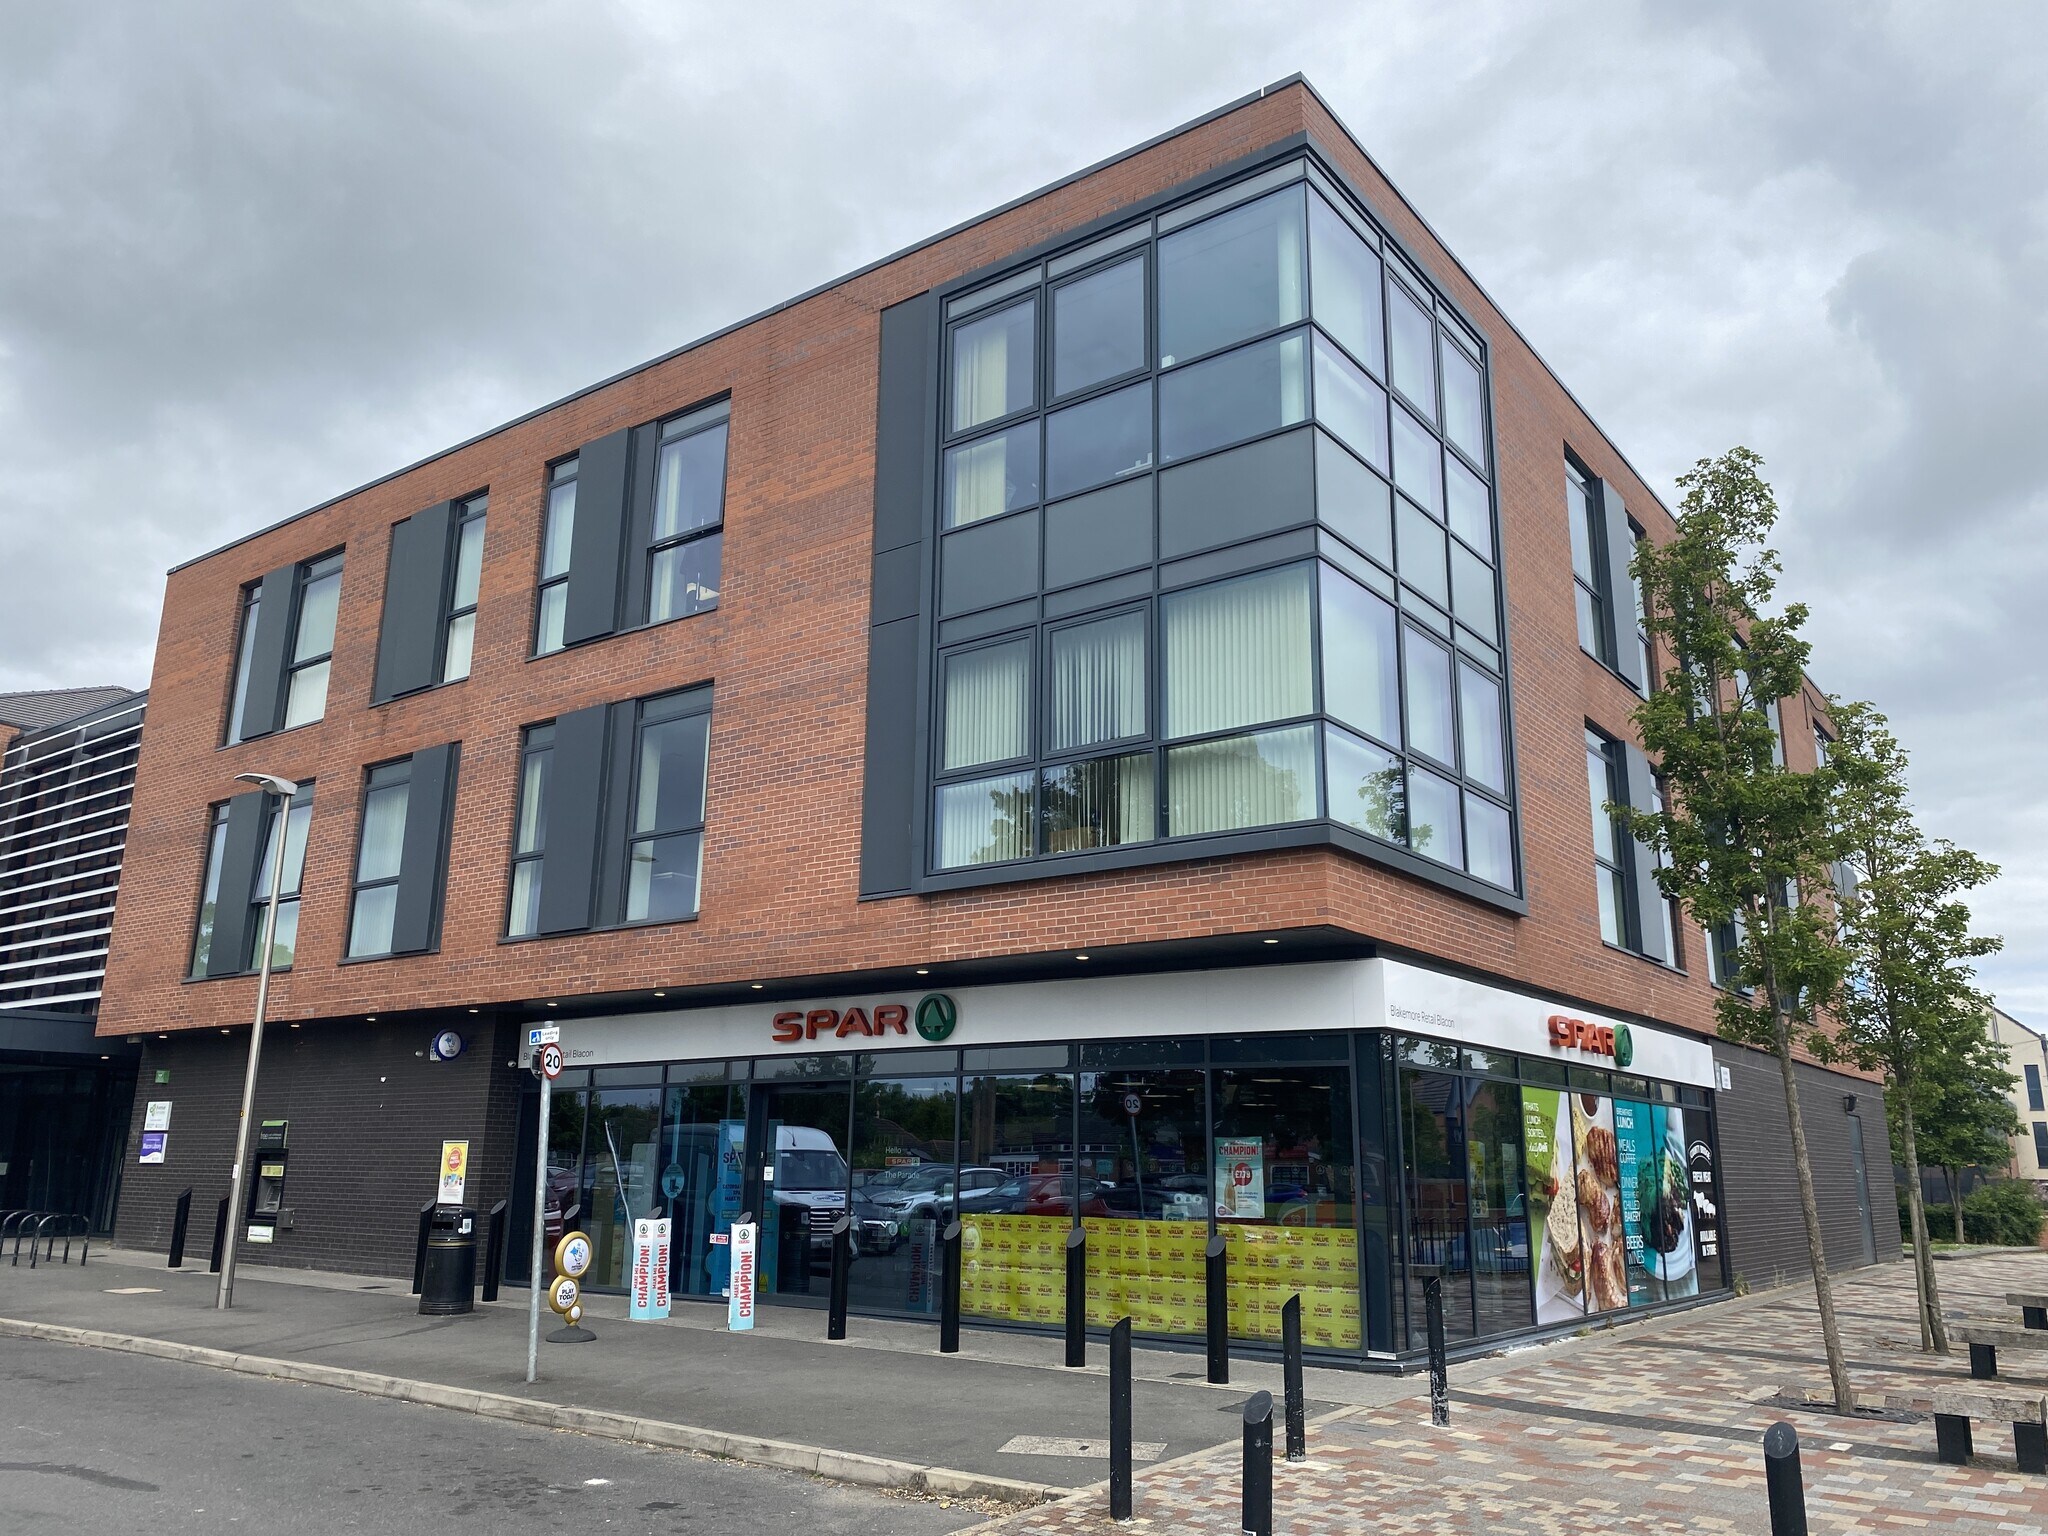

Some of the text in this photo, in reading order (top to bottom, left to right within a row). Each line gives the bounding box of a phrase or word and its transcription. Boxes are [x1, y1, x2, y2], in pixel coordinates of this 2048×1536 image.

[772, 1004, 908, 1042] SPAR
[1390, 1004, 1456, 1028] Blakemore Retail Blacon
[1548, 1014, 1616, 1056] SPAR
[546, 1053, 560, 1069] 20
[573, 1050, 594, 1058] Blacon
[1616, 1116, 1634, 1129] LUNCH
[1219, 1146, 1258, 1155] CHAMPION!
[1620, 1153, 1636, 1164] COFFEE
[1621, 1177, 1638, 1188] DINNER
[1626, 1235, 1644, 1250] BEERS
[1628, 1250, 1645, 1264] WINES
[638, 1245, 649, 1307] CHAMPION!
[657, 1244, 668, 1307] CHAMPION!
[740, 1251, 752, 1317] CHAMPION!
